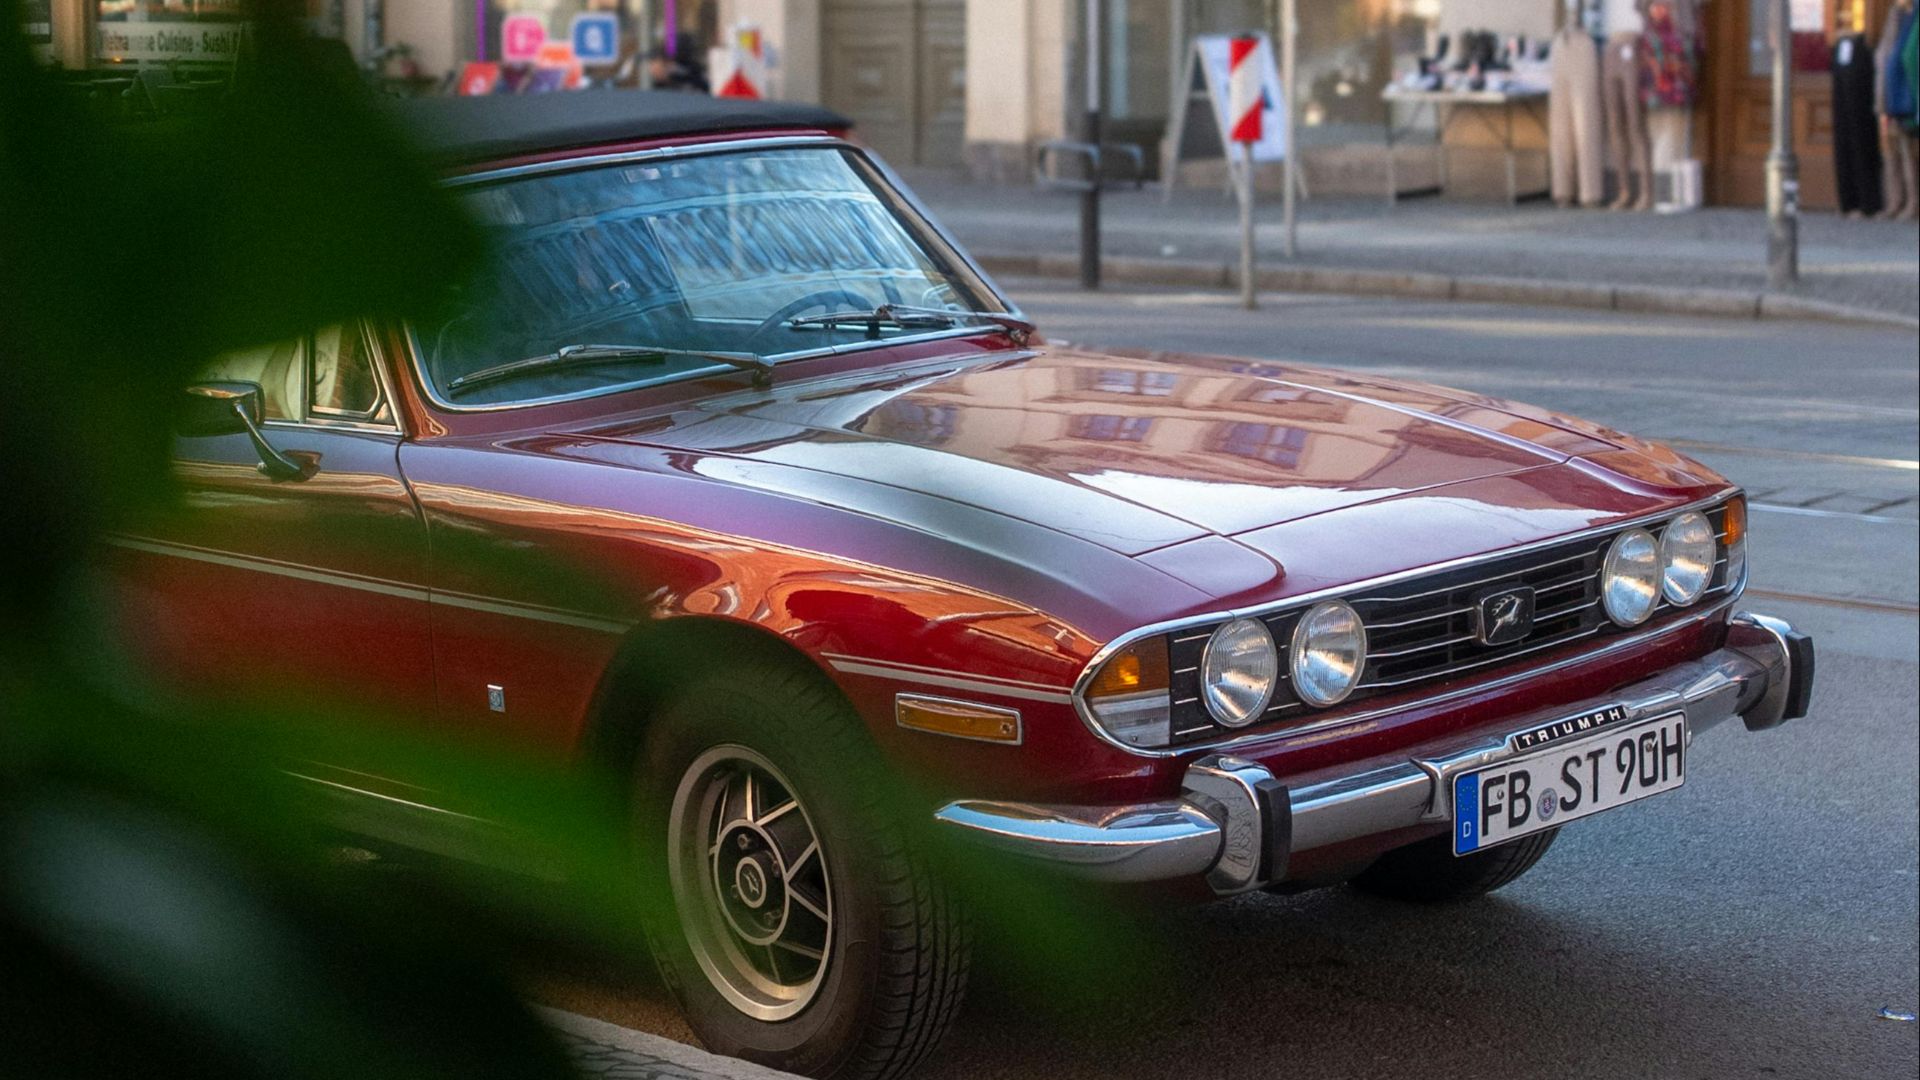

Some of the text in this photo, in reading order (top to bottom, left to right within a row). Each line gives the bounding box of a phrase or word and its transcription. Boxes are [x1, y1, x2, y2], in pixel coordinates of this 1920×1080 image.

[157, 30, 193, 52] Cuisine
[203, 31, 231, 53] Sushi
[1522, 710, 1622, 746] TRIUMPH
[1481, 723, 1682, 836] FB ST 90H
[1463, 821, 1472, 838] D
